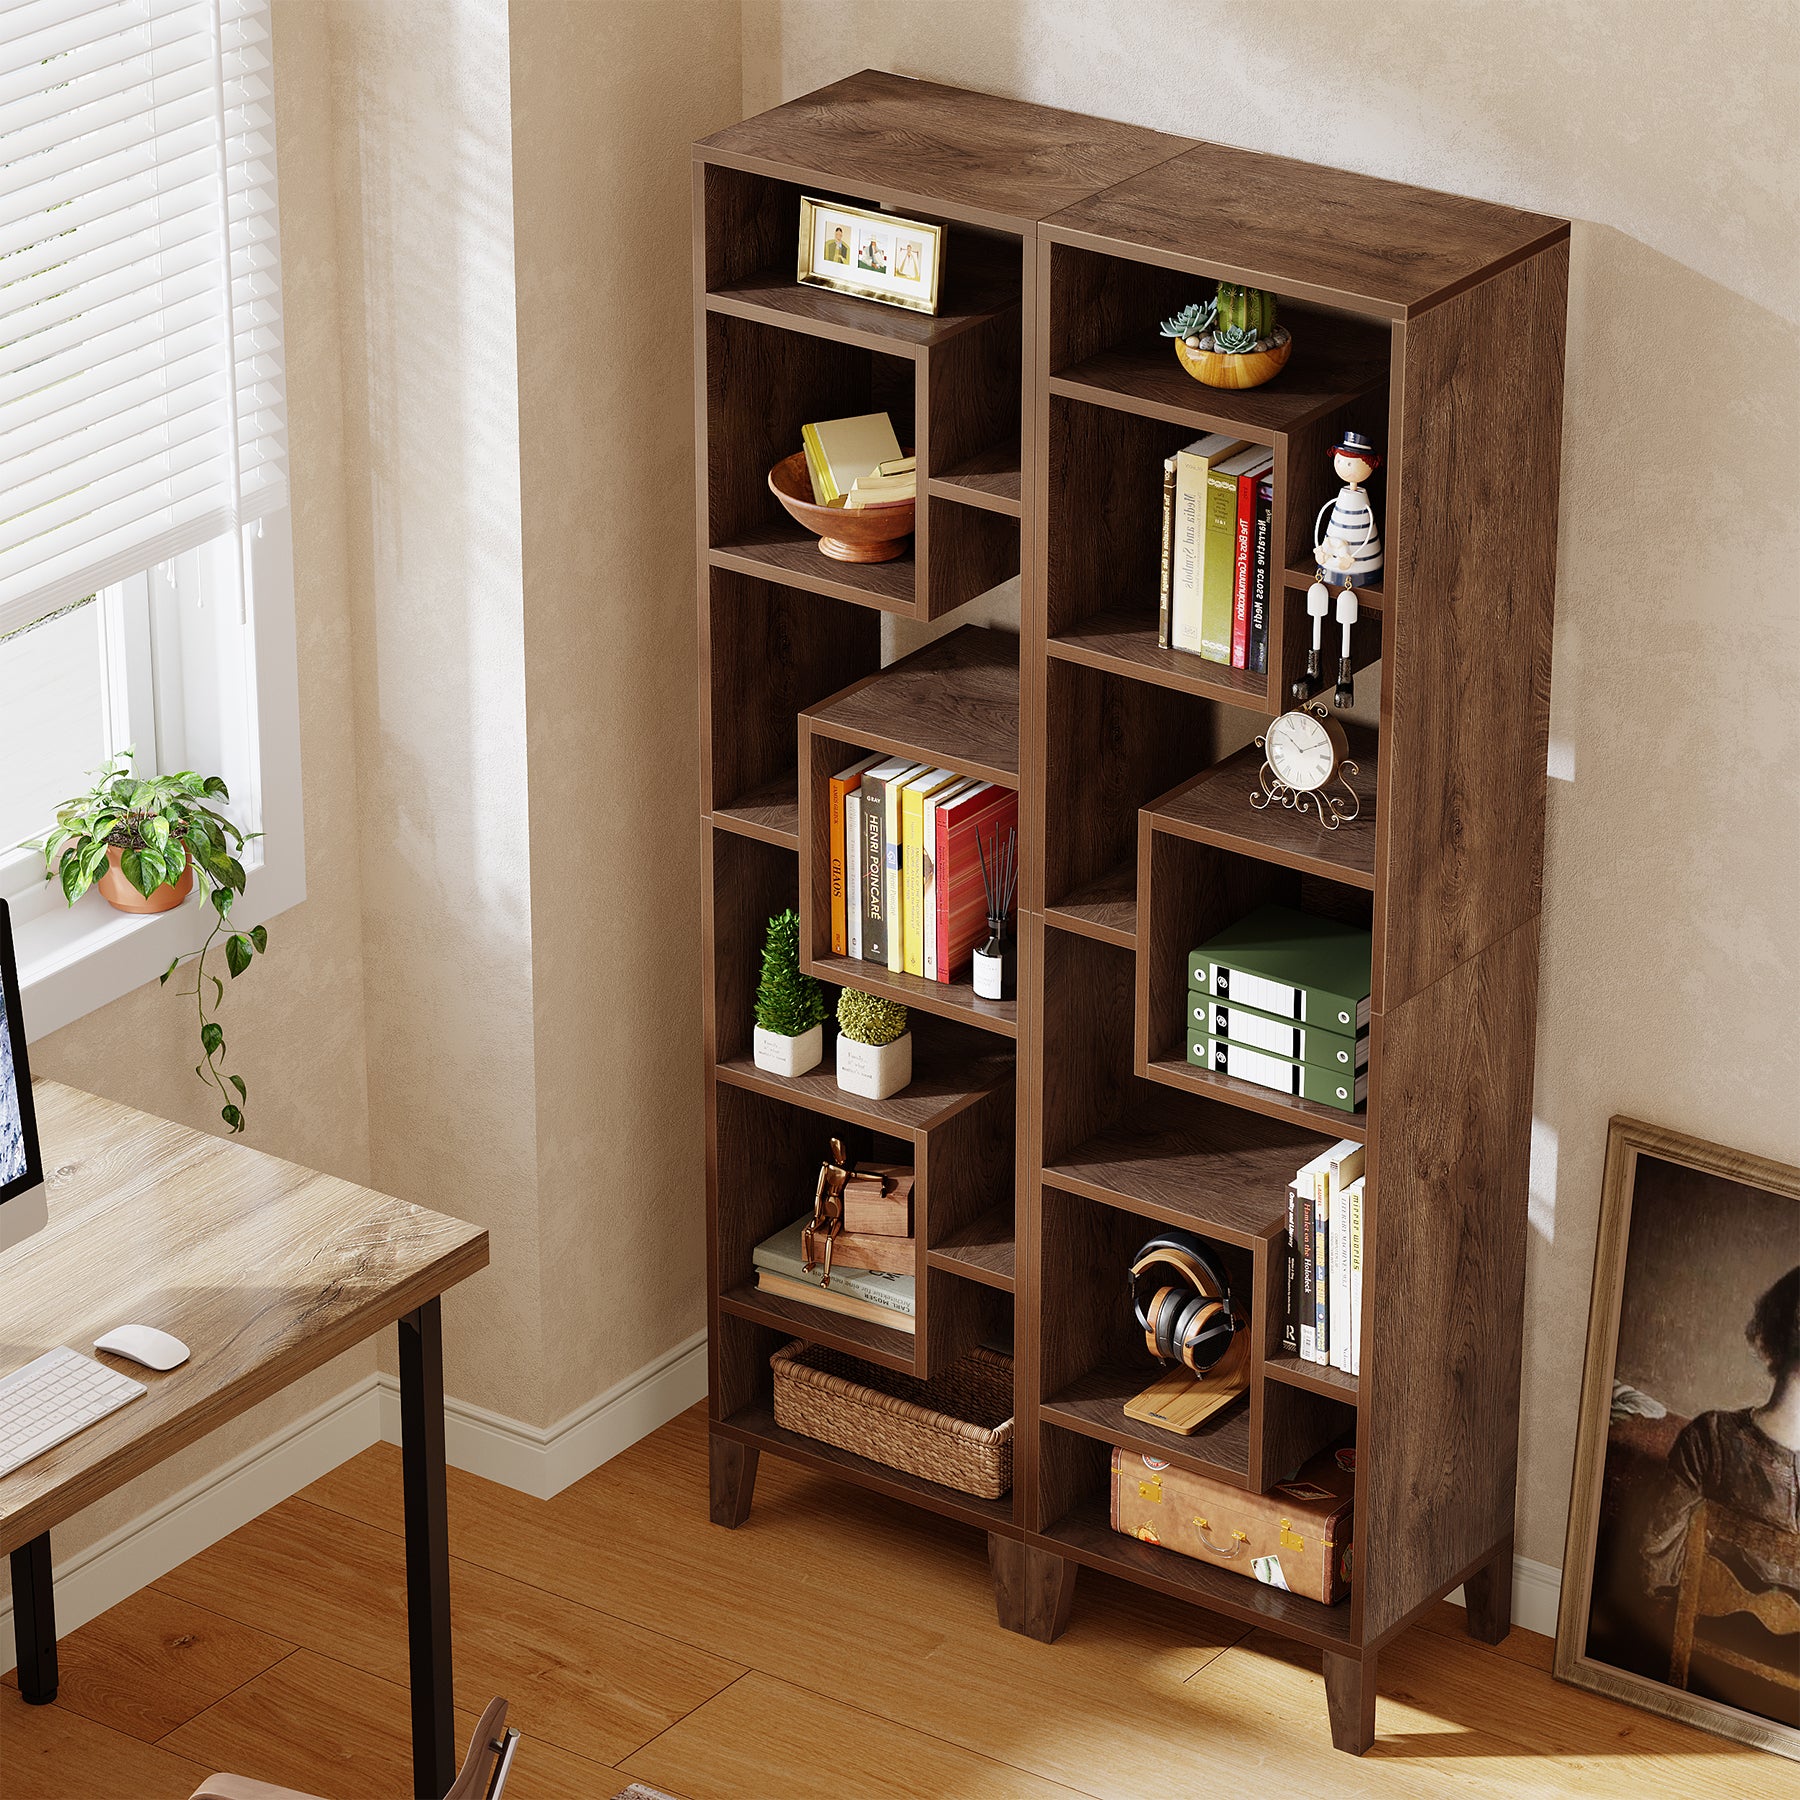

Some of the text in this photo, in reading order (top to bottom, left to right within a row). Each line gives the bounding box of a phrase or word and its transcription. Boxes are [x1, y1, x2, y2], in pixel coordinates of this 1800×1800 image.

[866, 795, 881, 804] GRAY
[869, 814, 881, 920] HENRI POINCARÉ
[832, 858, 842, 898] CHAOS
[1352, 1194, 1360, 1231] mirror
[1304, 1232, 1309, 1243] on
[864, 1294, 911, 1313] CARL MOSER
[872, 1290, 911, 1307] Architektur
